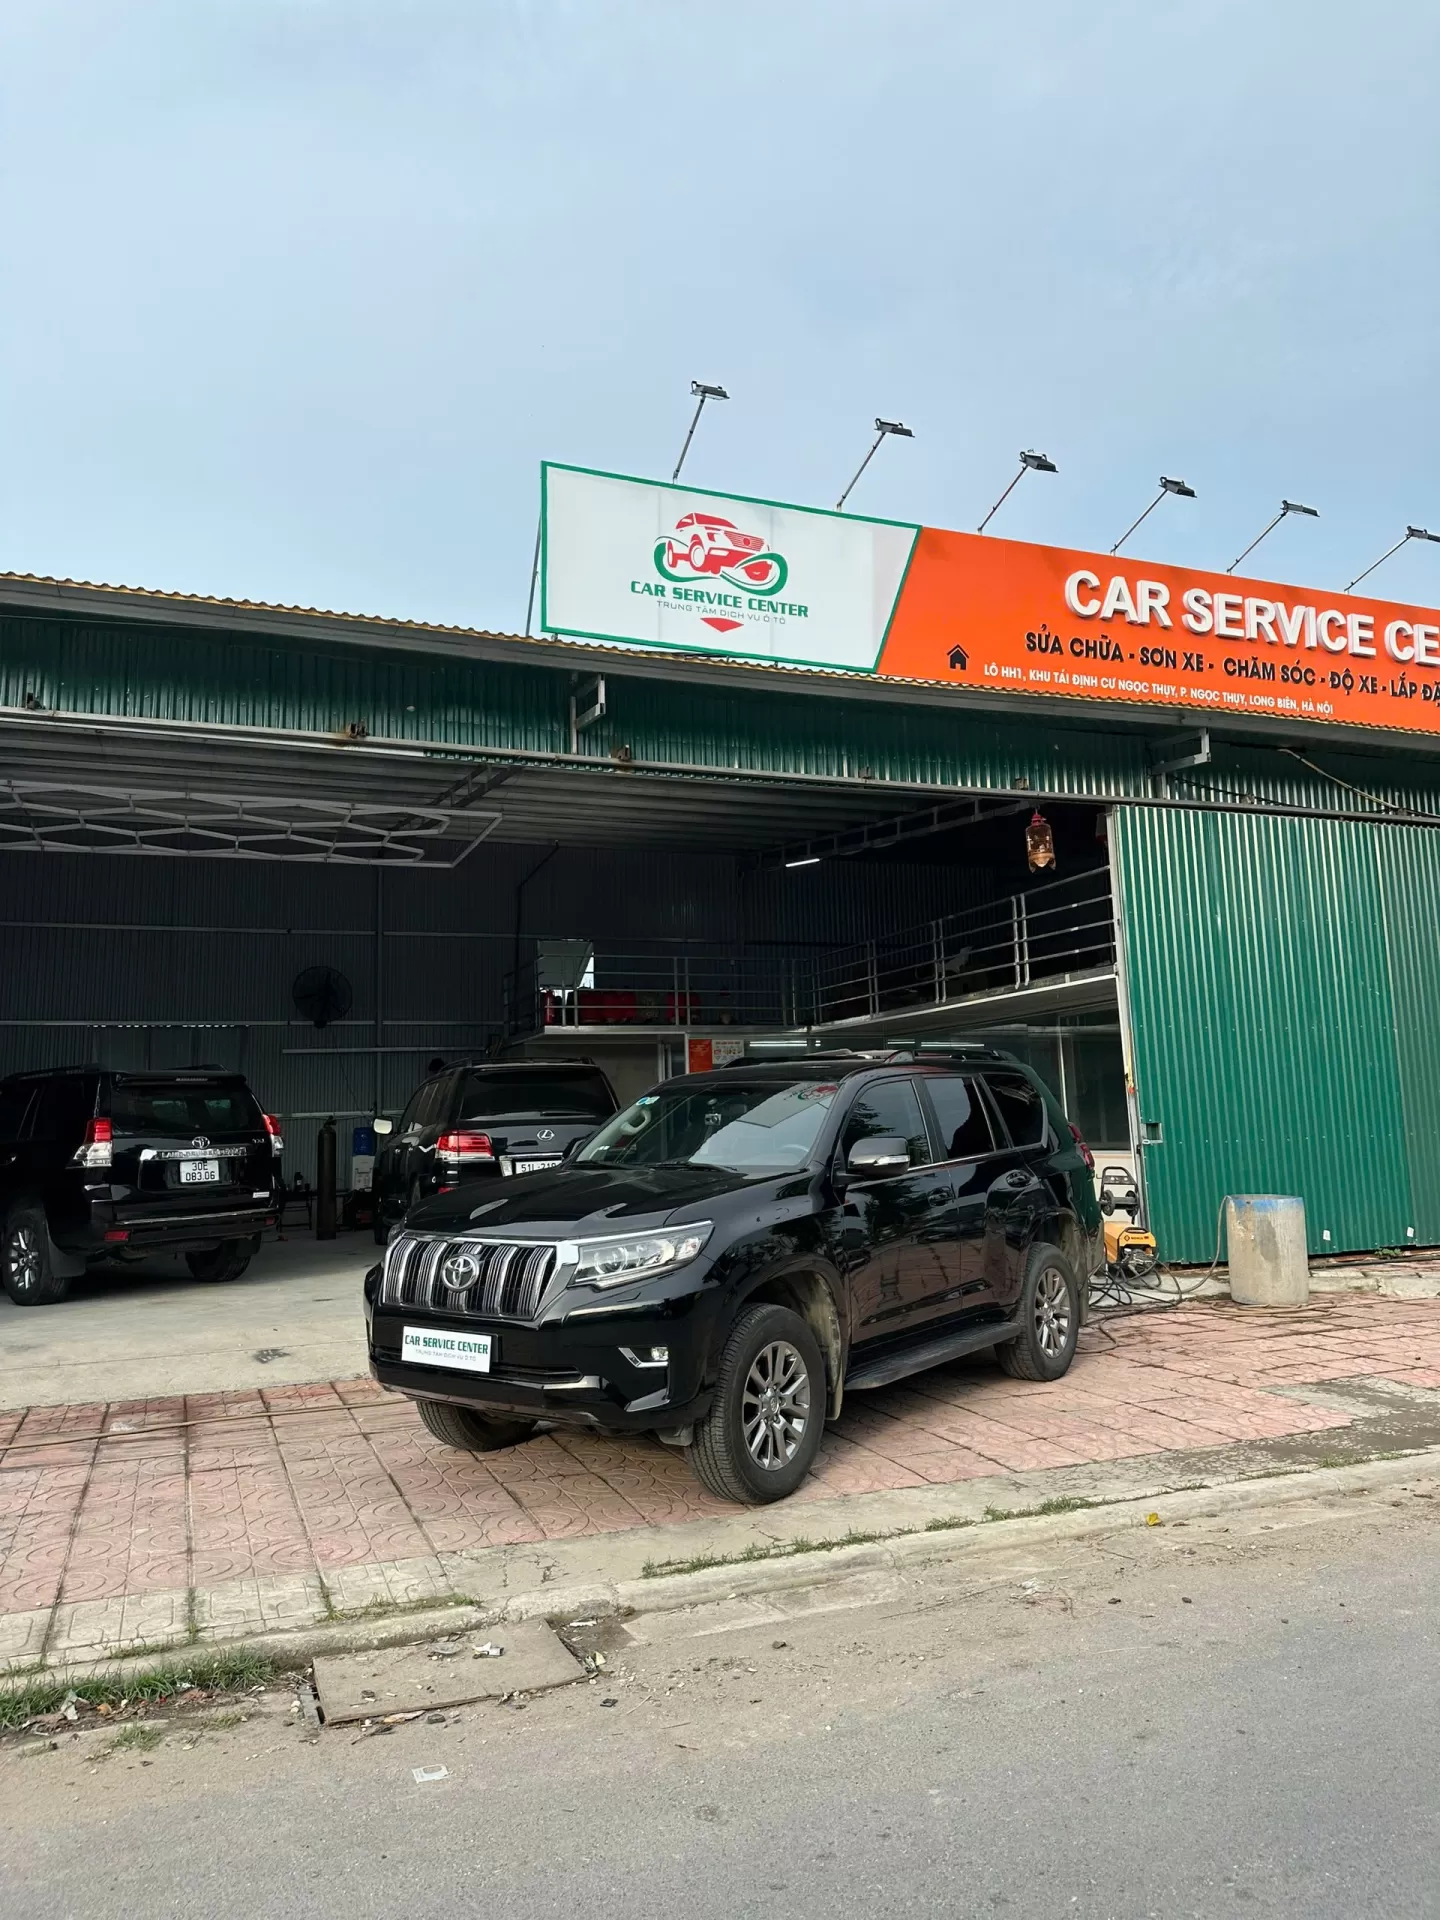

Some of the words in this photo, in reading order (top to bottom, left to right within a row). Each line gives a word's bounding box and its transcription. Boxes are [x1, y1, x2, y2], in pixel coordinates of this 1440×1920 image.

[631, 580, 666, 598] CAR
[672, 587, 742, 609] SERVICE
[748, 598, 809, 618] CENTER
[657, 600, 692, 612] TRUNG
[1064, 570, 1173, 629] CAR
[1182, 588, 1377, 657] SERVICE
[1384, 620, 1440, 667] CE
[1025, 624, 1064, 655] SỬA
[1069, 634, 1124, 662] CHỮA
[1139, 646, 1177, 669] SƠN
[1182, 651, 1204, 672] XE
[1223, 656, 1276, 681] CHĂM
[1281, 660, 1316, 686] SÓC
[1329, 668, 1355, 695] ĐỘ
[1358, 675, 1378, 694] XE
[1389, 672, 1418, 699] LẮP
[984, 662, 999, 677] LÔ
[1029, 669, 1051, 682] KHU
[1053, 669, 1070, 684] TÁI
[1072, 673, 1098, 689] ĐỊNH
[1100, 677, 1117, 689] CƯ
[1118, 679, 1150, 695] NGỌC
[1180, 686, 1188, 698] P.
[1190, 688, 1221, 703] NGỌC
[1249, 695, 1275, 707] LONG
[1301, 698, 1315, 712] HÀ
[1316, 701, 1333, 717] NỘI
[404, 1334, 420, 1346] CAR
[422, 1336, 456, 1351] SERVICE
[457, 1341, 489, 1355] CENTER
